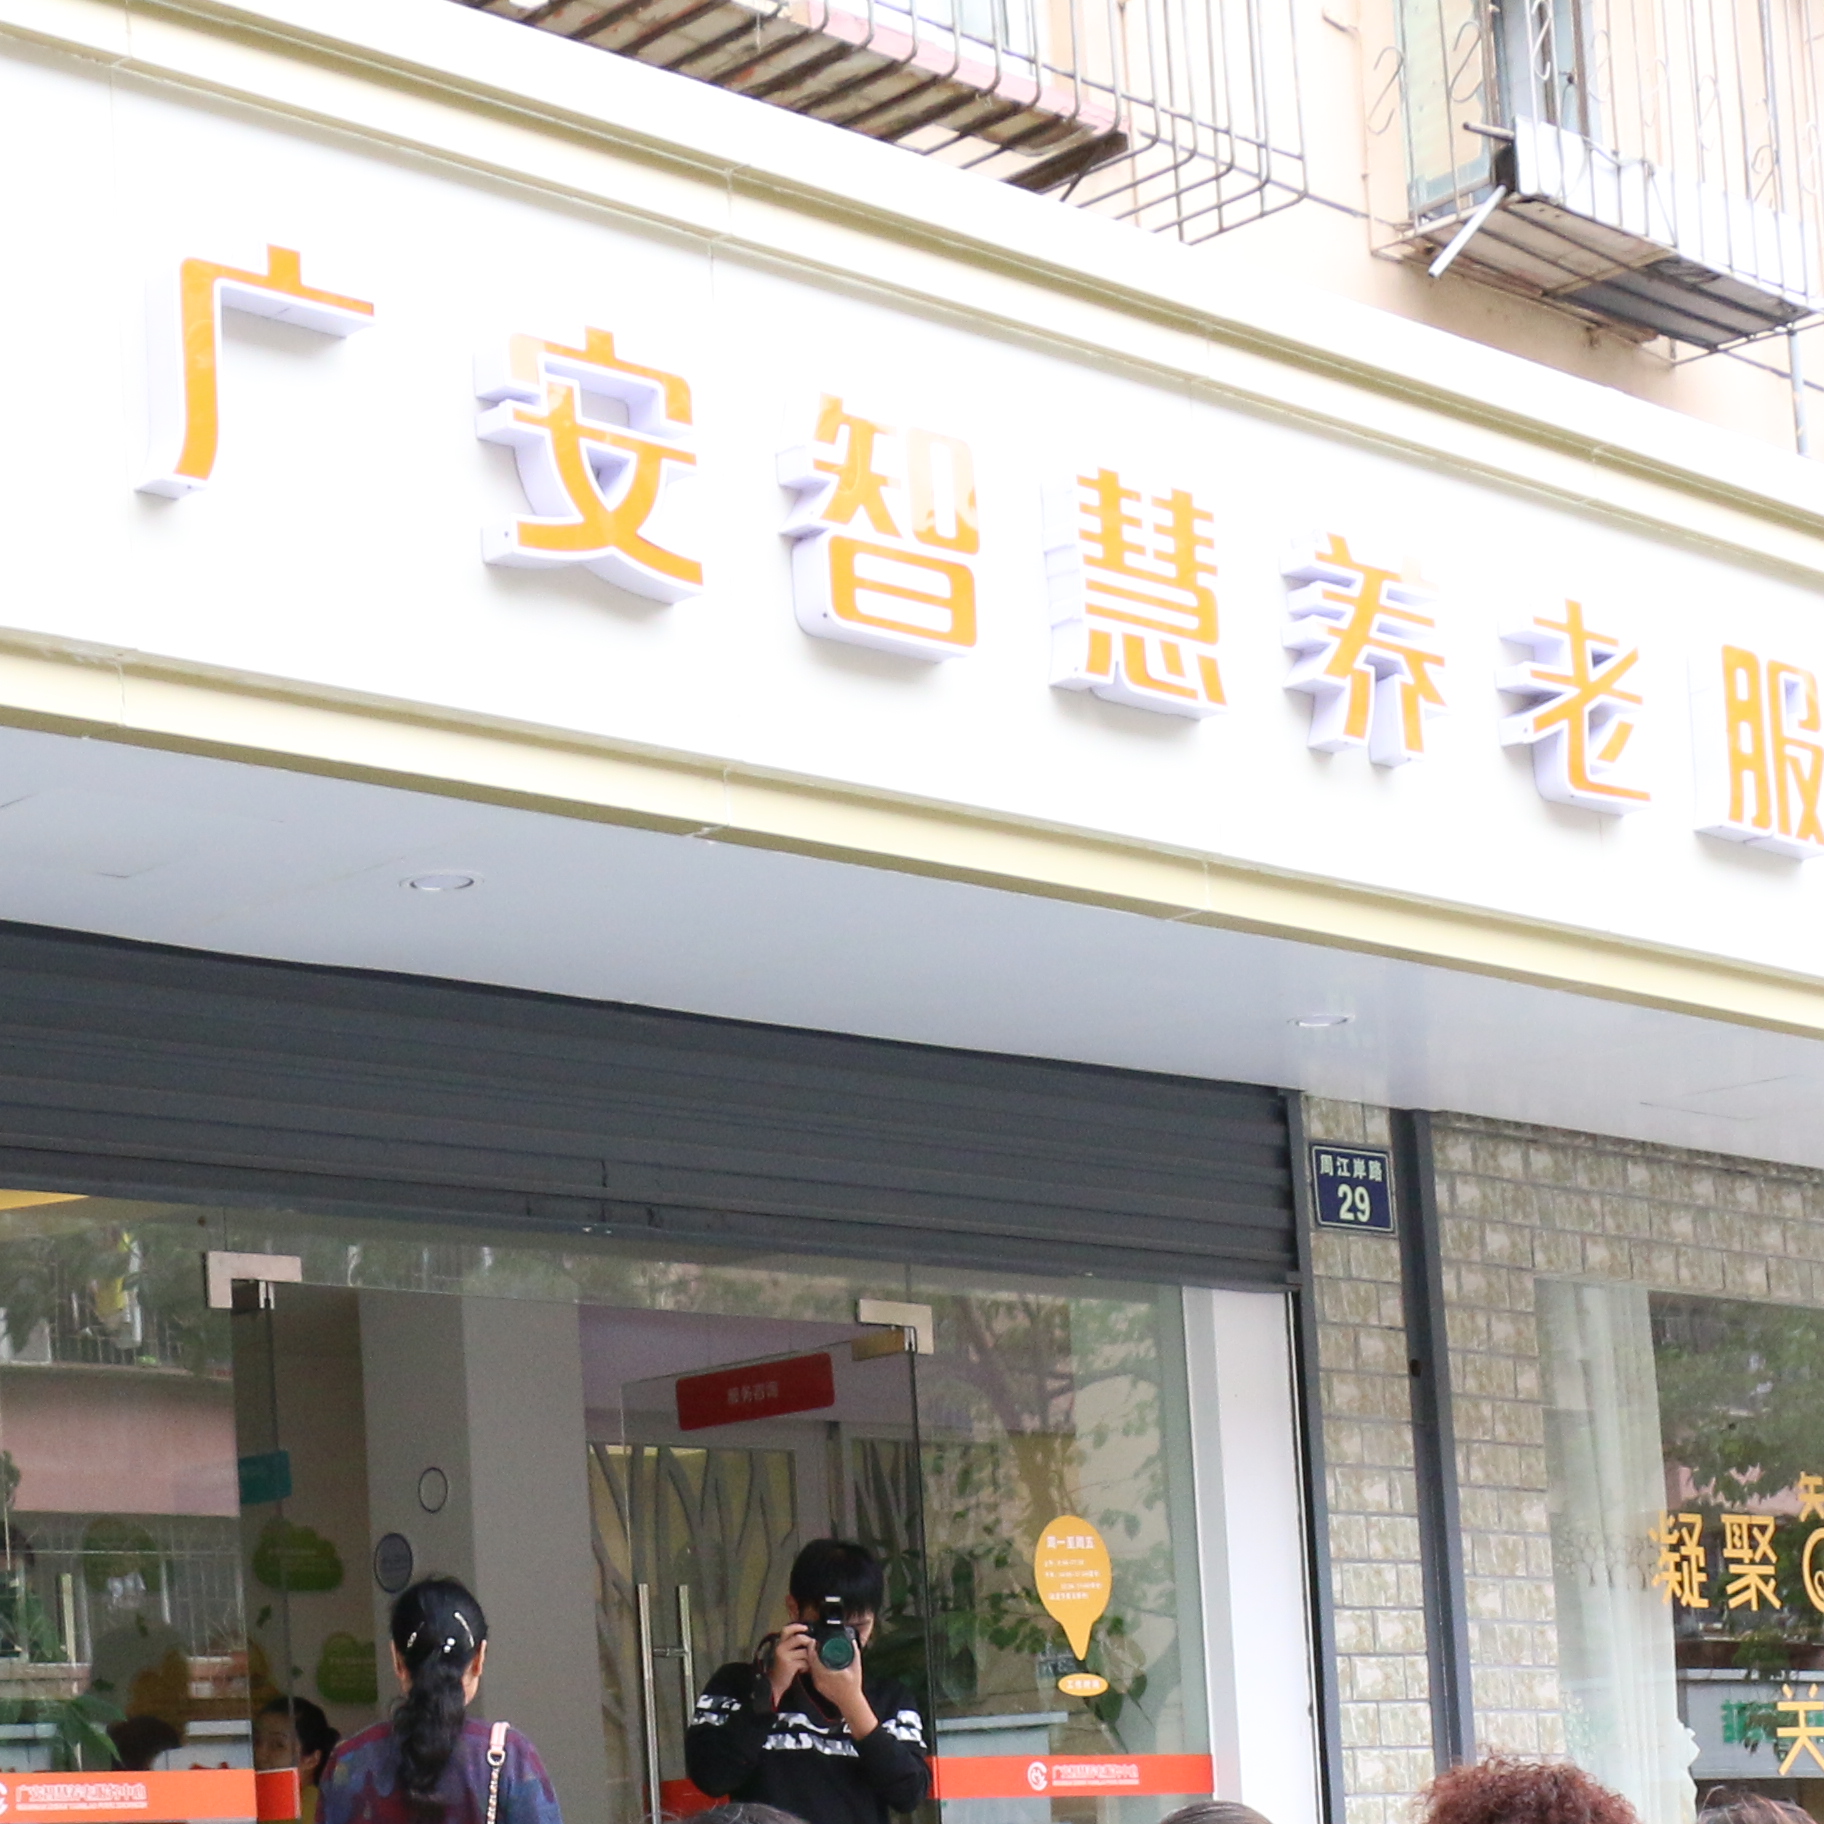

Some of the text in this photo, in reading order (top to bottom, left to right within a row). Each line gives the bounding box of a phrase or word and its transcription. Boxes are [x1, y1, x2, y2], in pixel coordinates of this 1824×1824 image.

[1319, 1153, 1383, 1182] 周江岸路
[1337, 1183, 1371, 1223] 29
